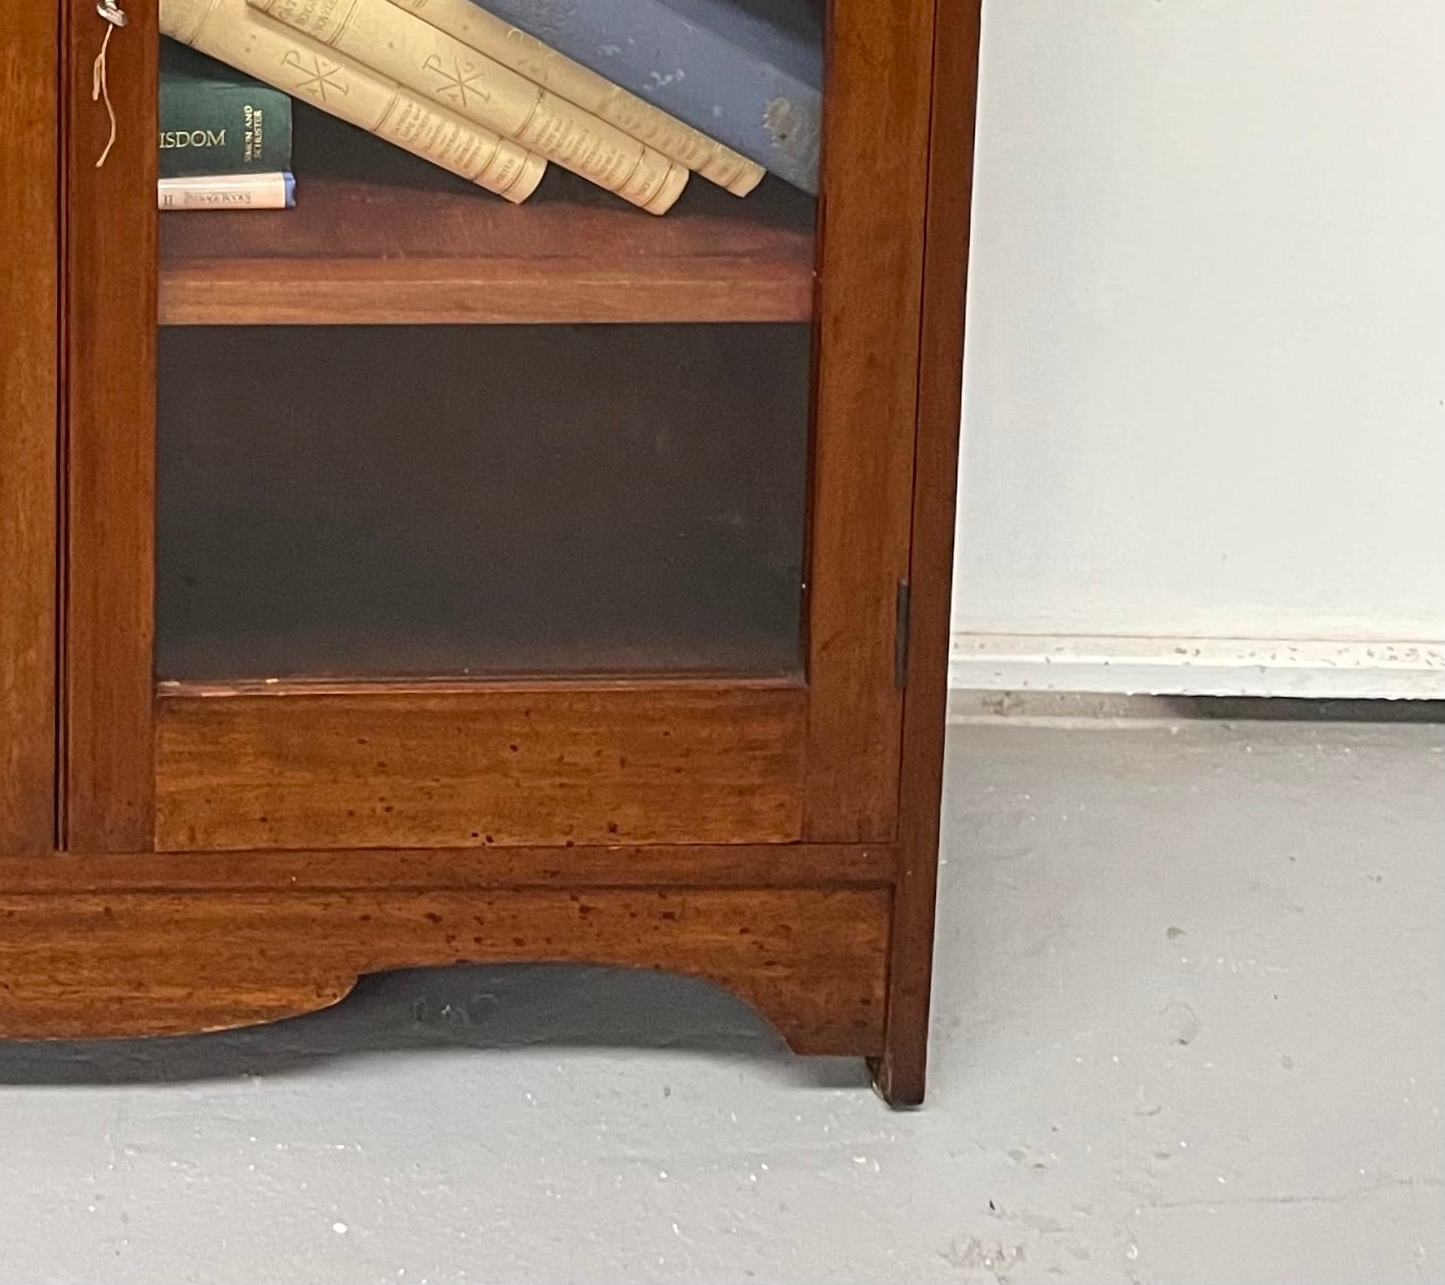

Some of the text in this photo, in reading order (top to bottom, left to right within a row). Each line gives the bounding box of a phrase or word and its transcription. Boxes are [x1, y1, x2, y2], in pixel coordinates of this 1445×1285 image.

[244, 105, 253, 128] AND
[159, 129, 227, 149] ISDOM
[253, 109, 263, 159] SCHUSTER
